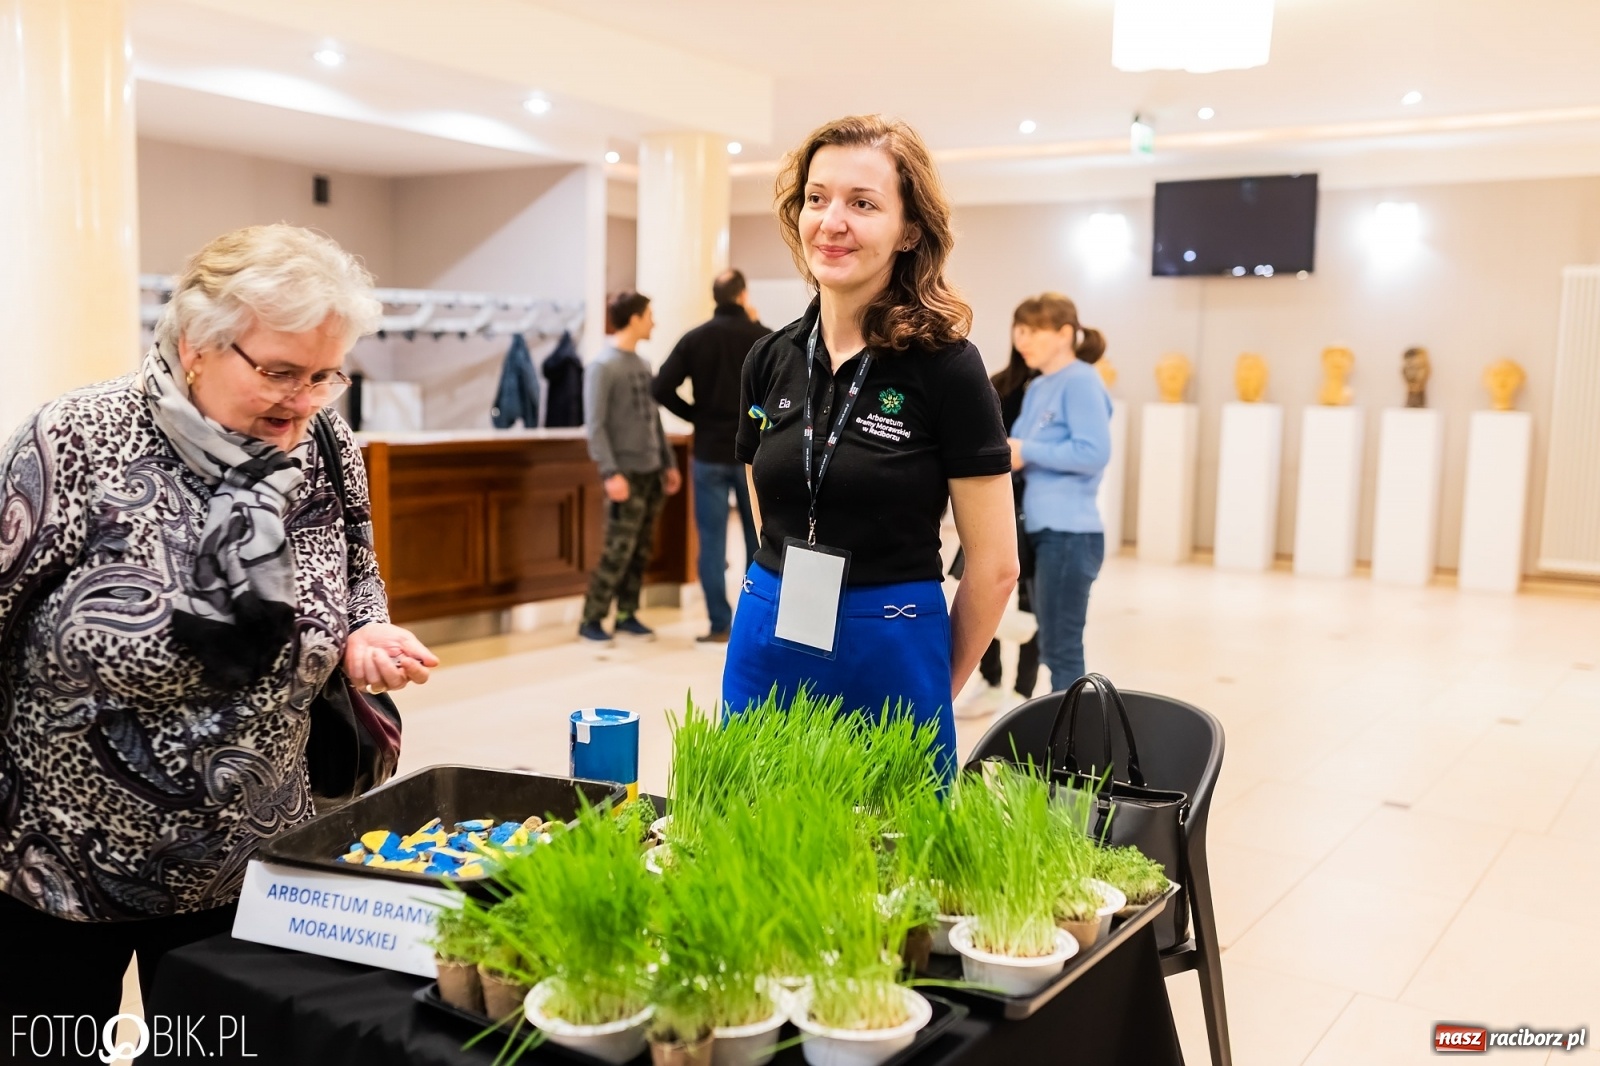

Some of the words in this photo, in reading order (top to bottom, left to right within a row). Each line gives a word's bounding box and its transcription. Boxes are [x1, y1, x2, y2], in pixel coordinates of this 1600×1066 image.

[855, 417, 876, 428] Bramy
[876, 422, 911, 438] Morawskiej
[867, 413, 904, 427] Arboretum
[869, 427, 901, 442] Raciborzu
[266, 883, 369, 915] ARBORETUM
[372, 901, 434, 926] BRAMY
[288, 917, 397, 951] MORAWSKIEJ
